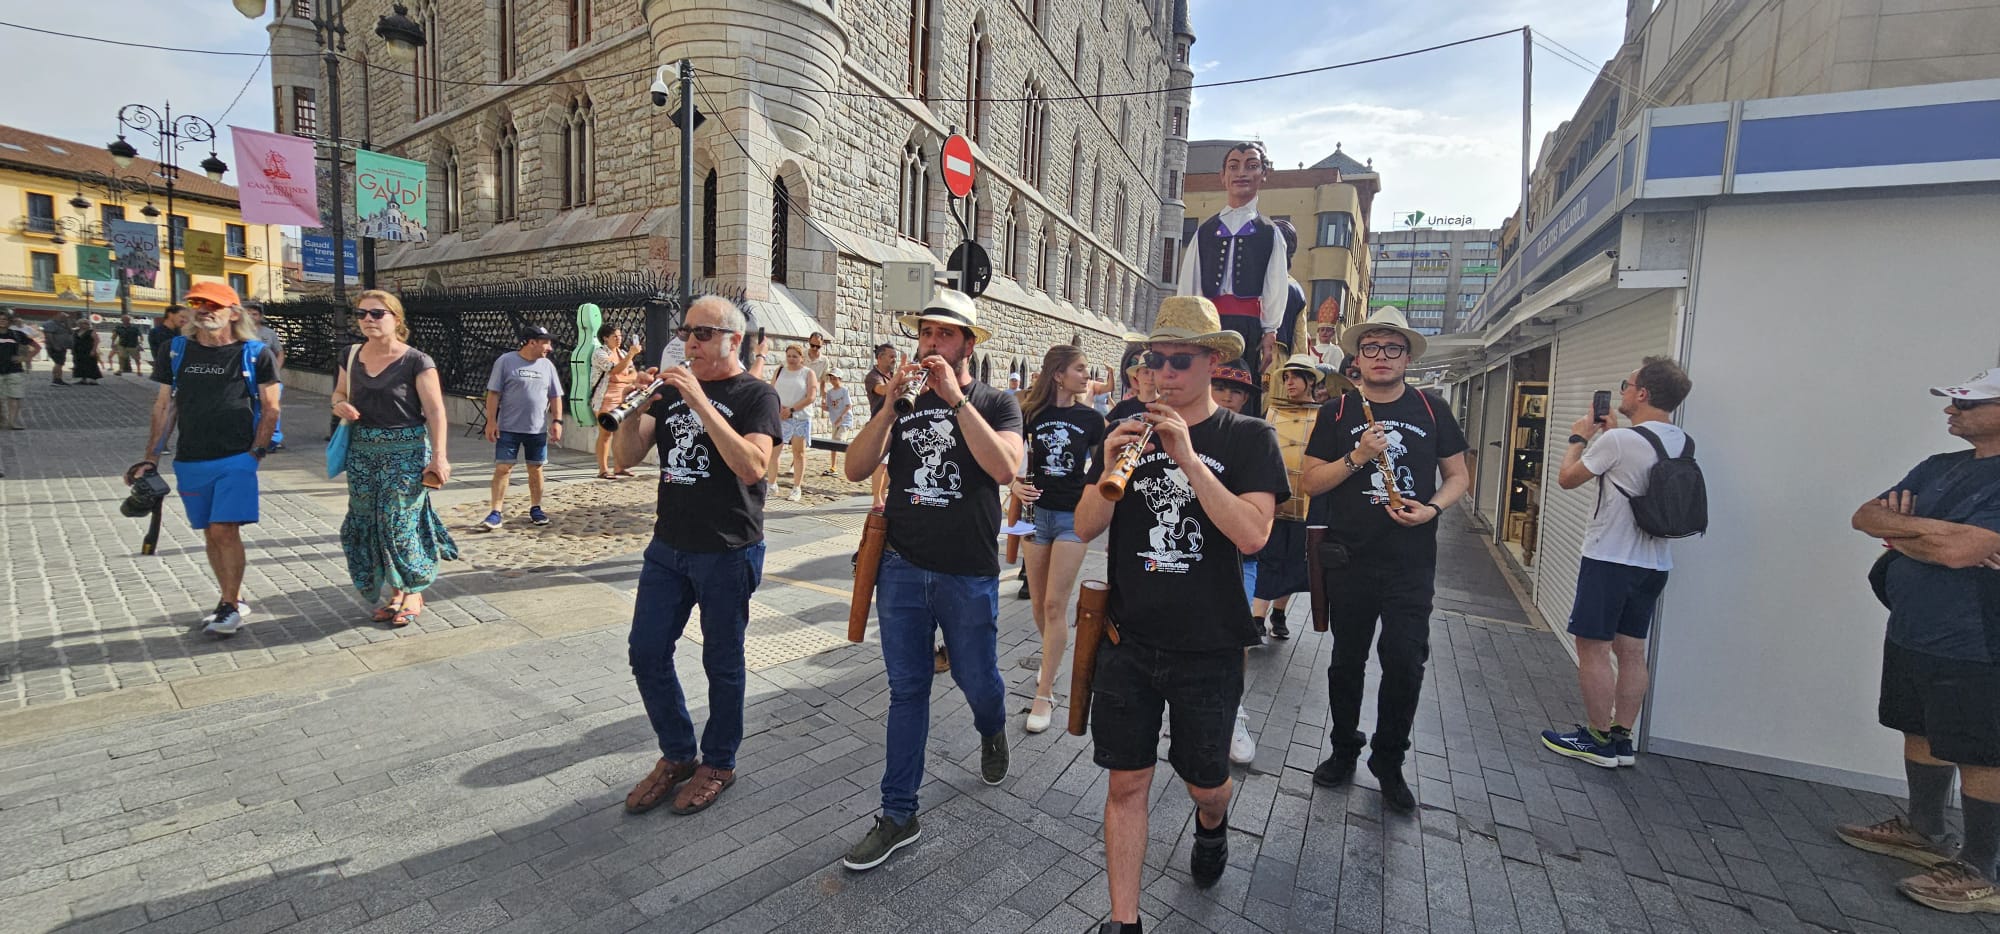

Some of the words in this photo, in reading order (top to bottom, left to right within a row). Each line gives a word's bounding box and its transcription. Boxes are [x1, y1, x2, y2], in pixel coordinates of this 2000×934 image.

[358, 173, 423, 205] GAUDÍ
[1427, 214, 1473, 227] Unicaja
[184, 366, 225, 375] ICELAND
[1147, 454, 1156, 463] DE
[1198, 453, 1225, 473] TAMBOR
[1966, 886, 1994, 899] HOKA
